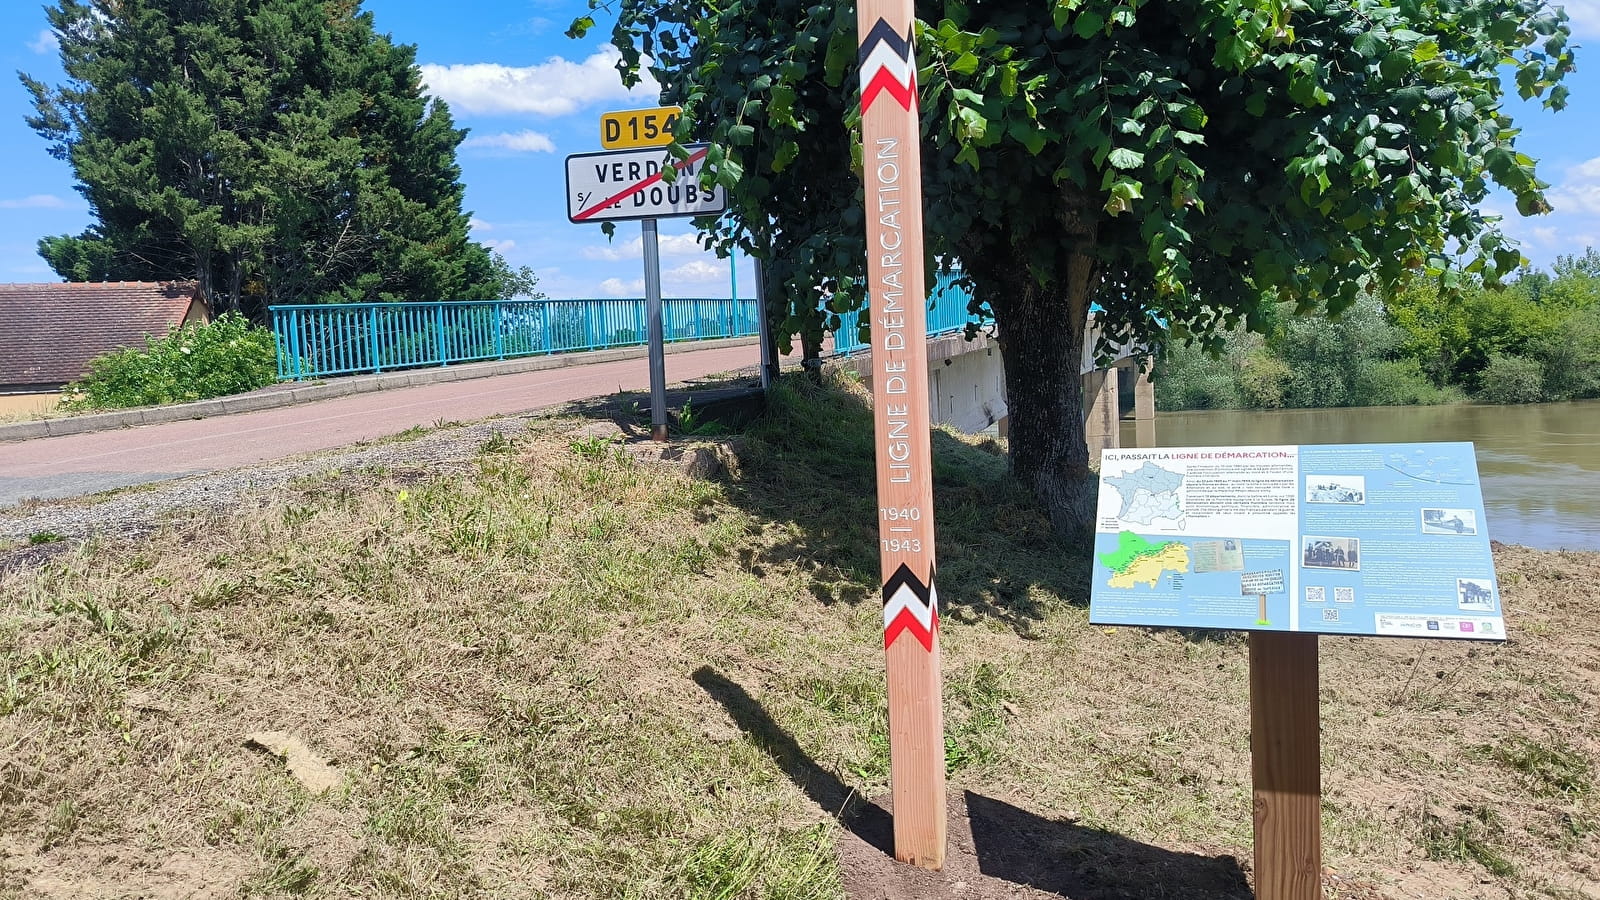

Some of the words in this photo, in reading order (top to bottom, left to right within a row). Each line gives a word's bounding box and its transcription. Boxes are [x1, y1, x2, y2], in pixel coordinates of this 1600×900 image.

[606, 119, 620, 143] D
[628, 113, 675, 141] 154
[595, 159, 694, 183] VERDN
[633, 184, 716, 207] DOUBS
[876, 137, 906, 350] DÉMARCATION
[885, 359, 908, 395] DE
[887, 403, 911, 483] LIGNE
[1120, 453, 1157, 461] PASSAIT
[1171, 452, 1199, 460] LIGNE
[880, 507, 921, 521] 1940
[881, 539, 921, 553] 1943
